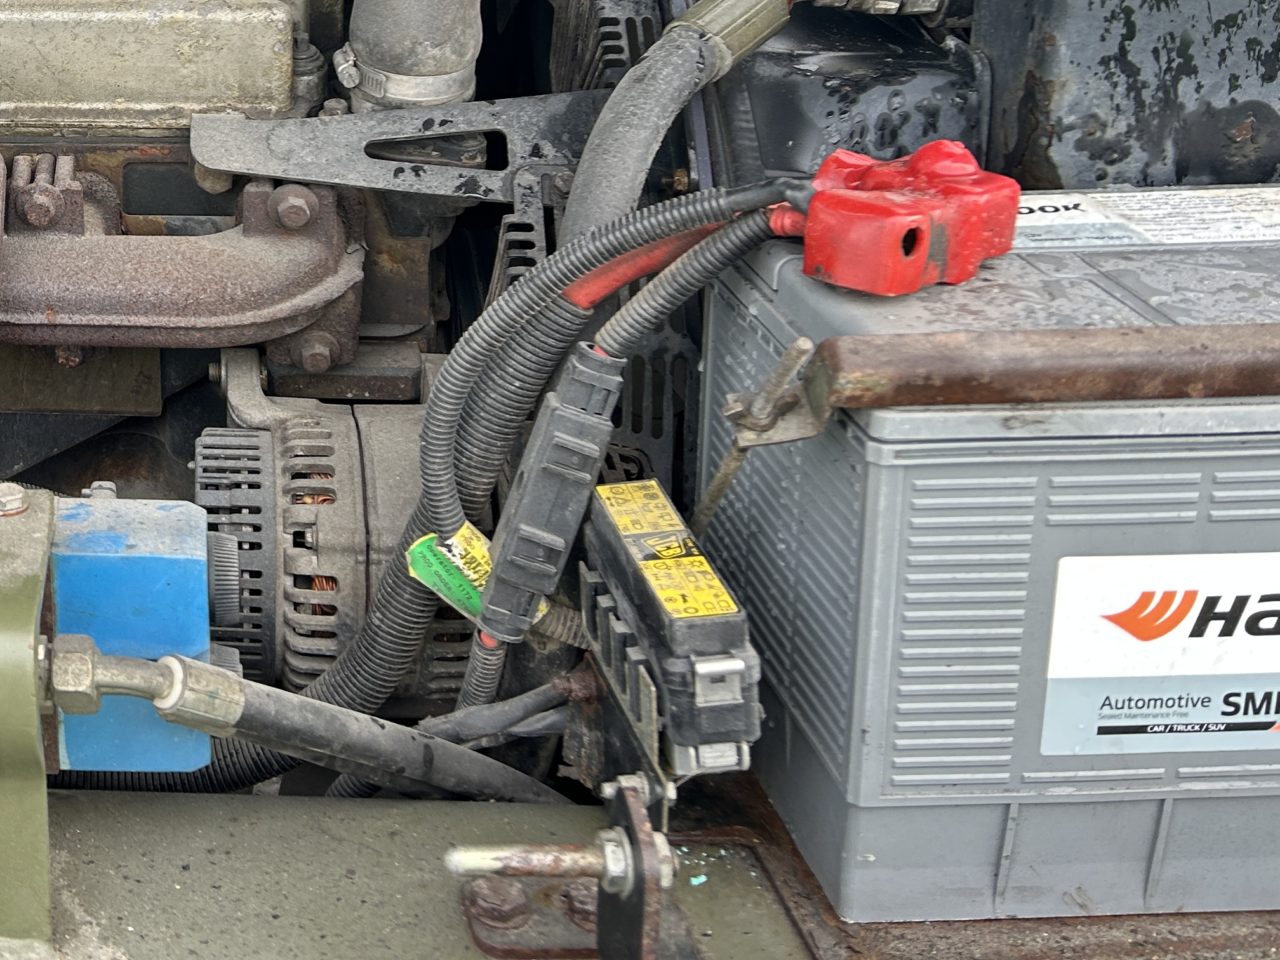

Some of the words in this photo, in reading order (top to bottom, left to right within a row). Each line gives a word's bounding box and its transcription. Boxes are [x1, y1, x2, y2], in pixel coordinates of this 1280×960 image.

[1018, 202, 1086, 216] OOK
[645, 535, 683, 557] JCB
[1100, 693, 1212, 710] Automotive
[1172, 710, 1190, 718] Free
[1147, 725, 1165, 733] CAR
[1173, 723, 1201, 732] TRUCK
[1208, 723, 1227, 731] SUV
